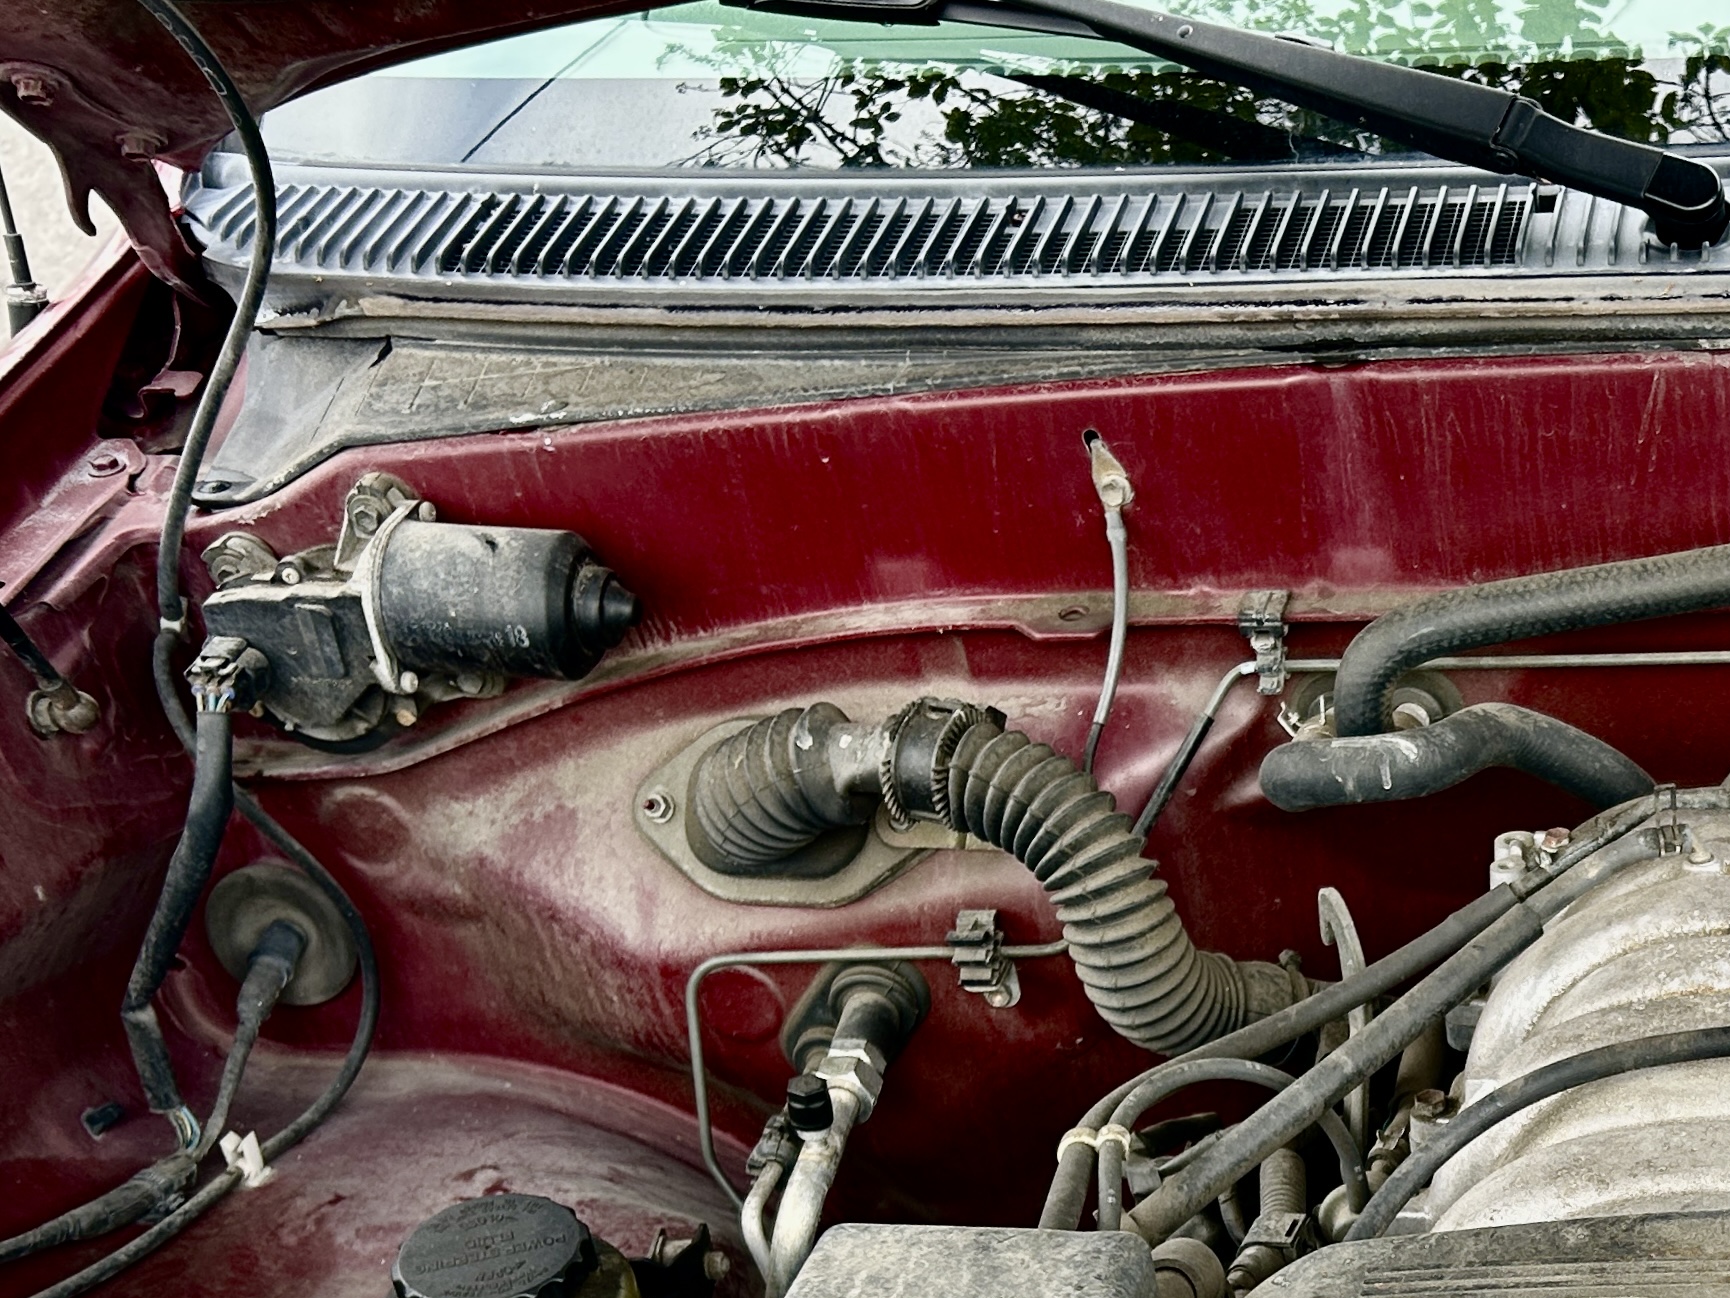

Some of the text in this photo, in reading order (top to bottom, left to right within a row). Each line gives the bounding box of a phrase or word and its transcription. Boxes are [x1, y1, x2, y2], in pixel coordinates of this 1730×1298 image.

[464, 1229, 515, 1249] FLUID
[415, 1234, 567, 1275] POWER STEERING
